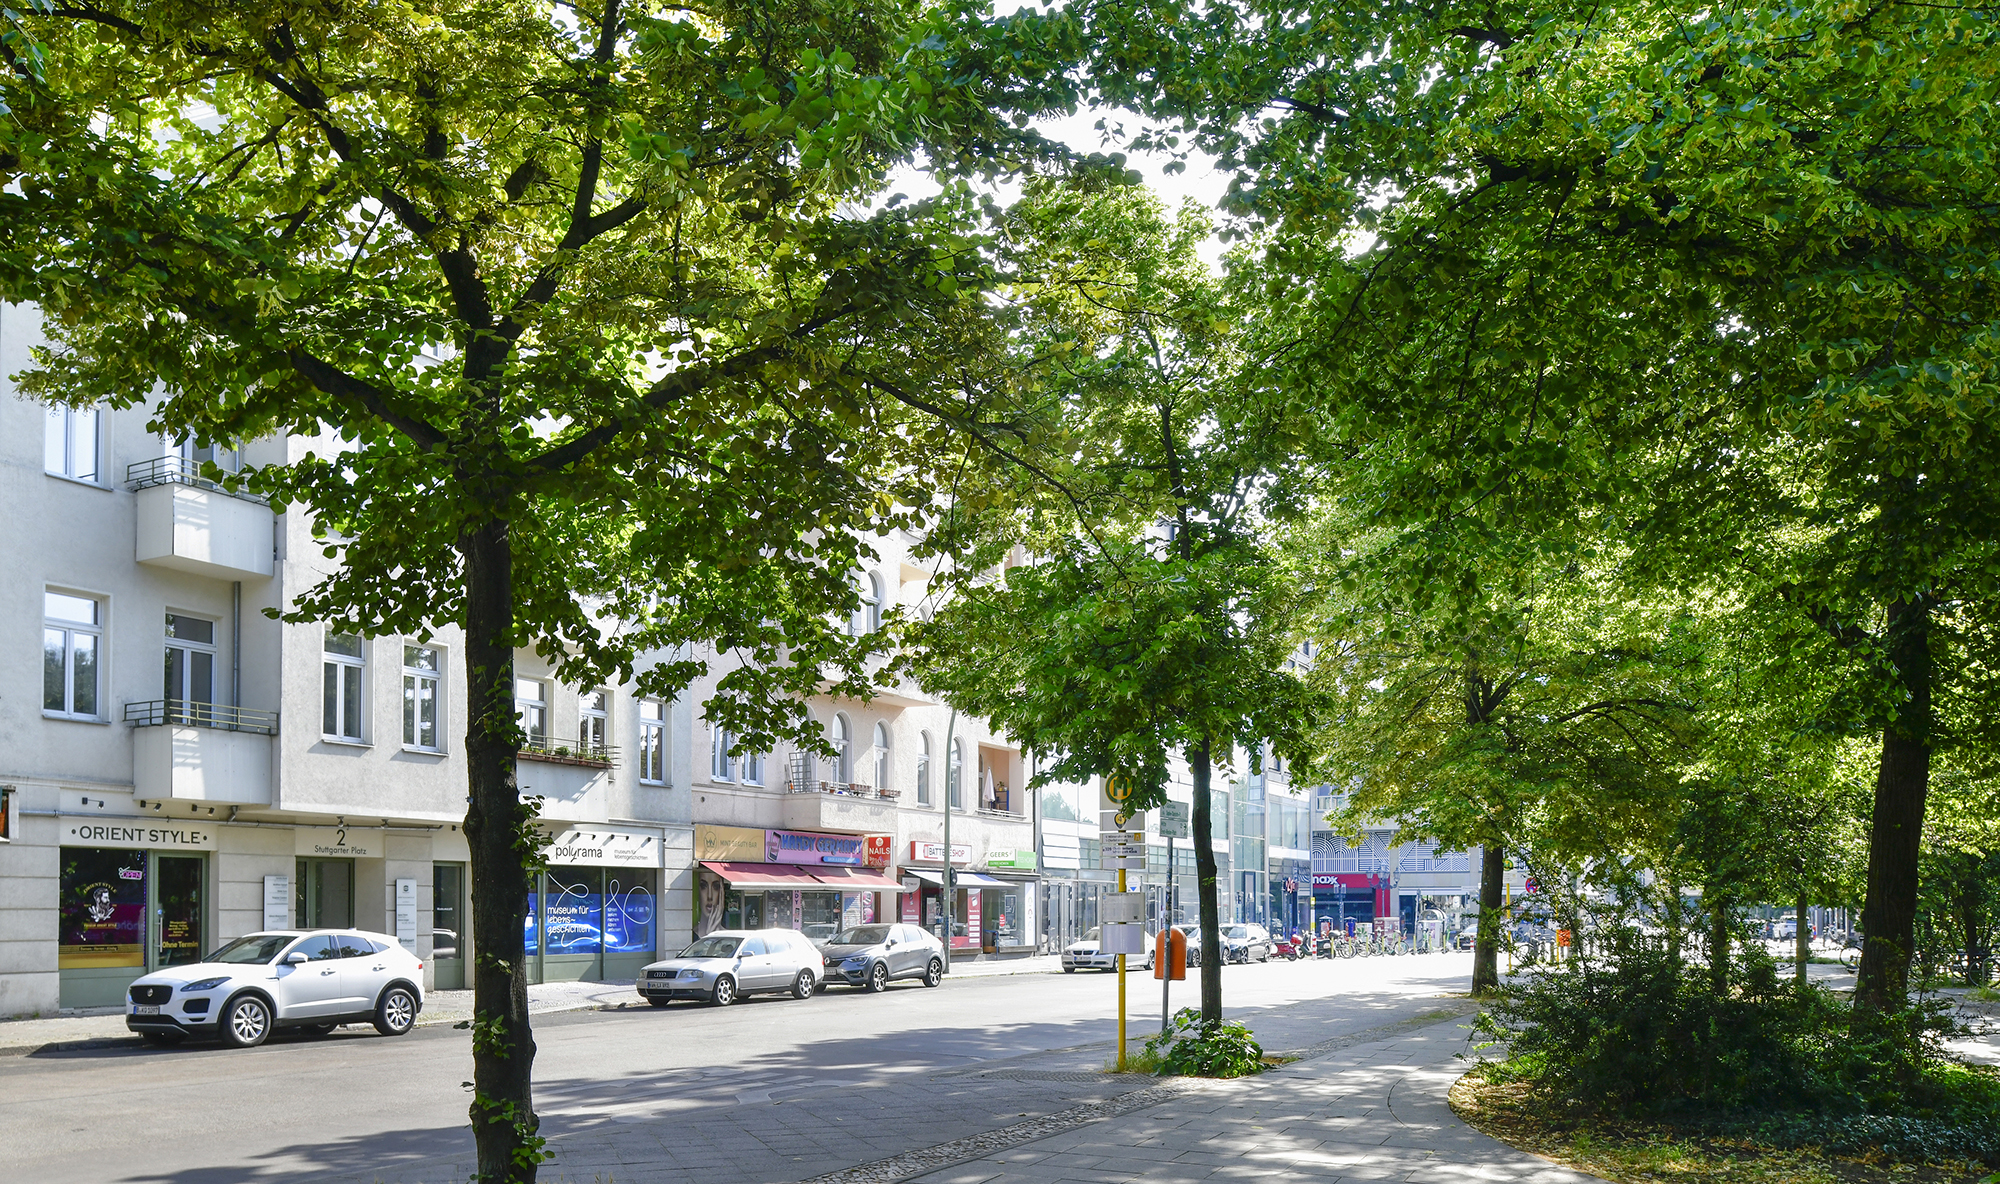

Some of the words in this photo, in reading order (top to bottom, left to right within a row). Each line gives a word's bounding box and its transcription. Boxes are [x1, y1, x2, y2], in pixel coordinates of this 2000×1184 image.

[80, 826, 145, 841] ORIENT
[149, 829, 200, 844] STYLE
[336, 829, 346, 846] 2
[314, 844, 349, 856] Stuttgarter
[351, 846, 367, 855] Platz
[780, 834, 816, 852] HANDY
[817, 837, 862, 856] GERMANY
[868, 847, 890, 855] NAILS
[555, 845, 603, 862] polyrama
[122, 871, 141, 879] OPEN
[547, 906, 578, 915] museum
[578, 905, 589, 915] für
